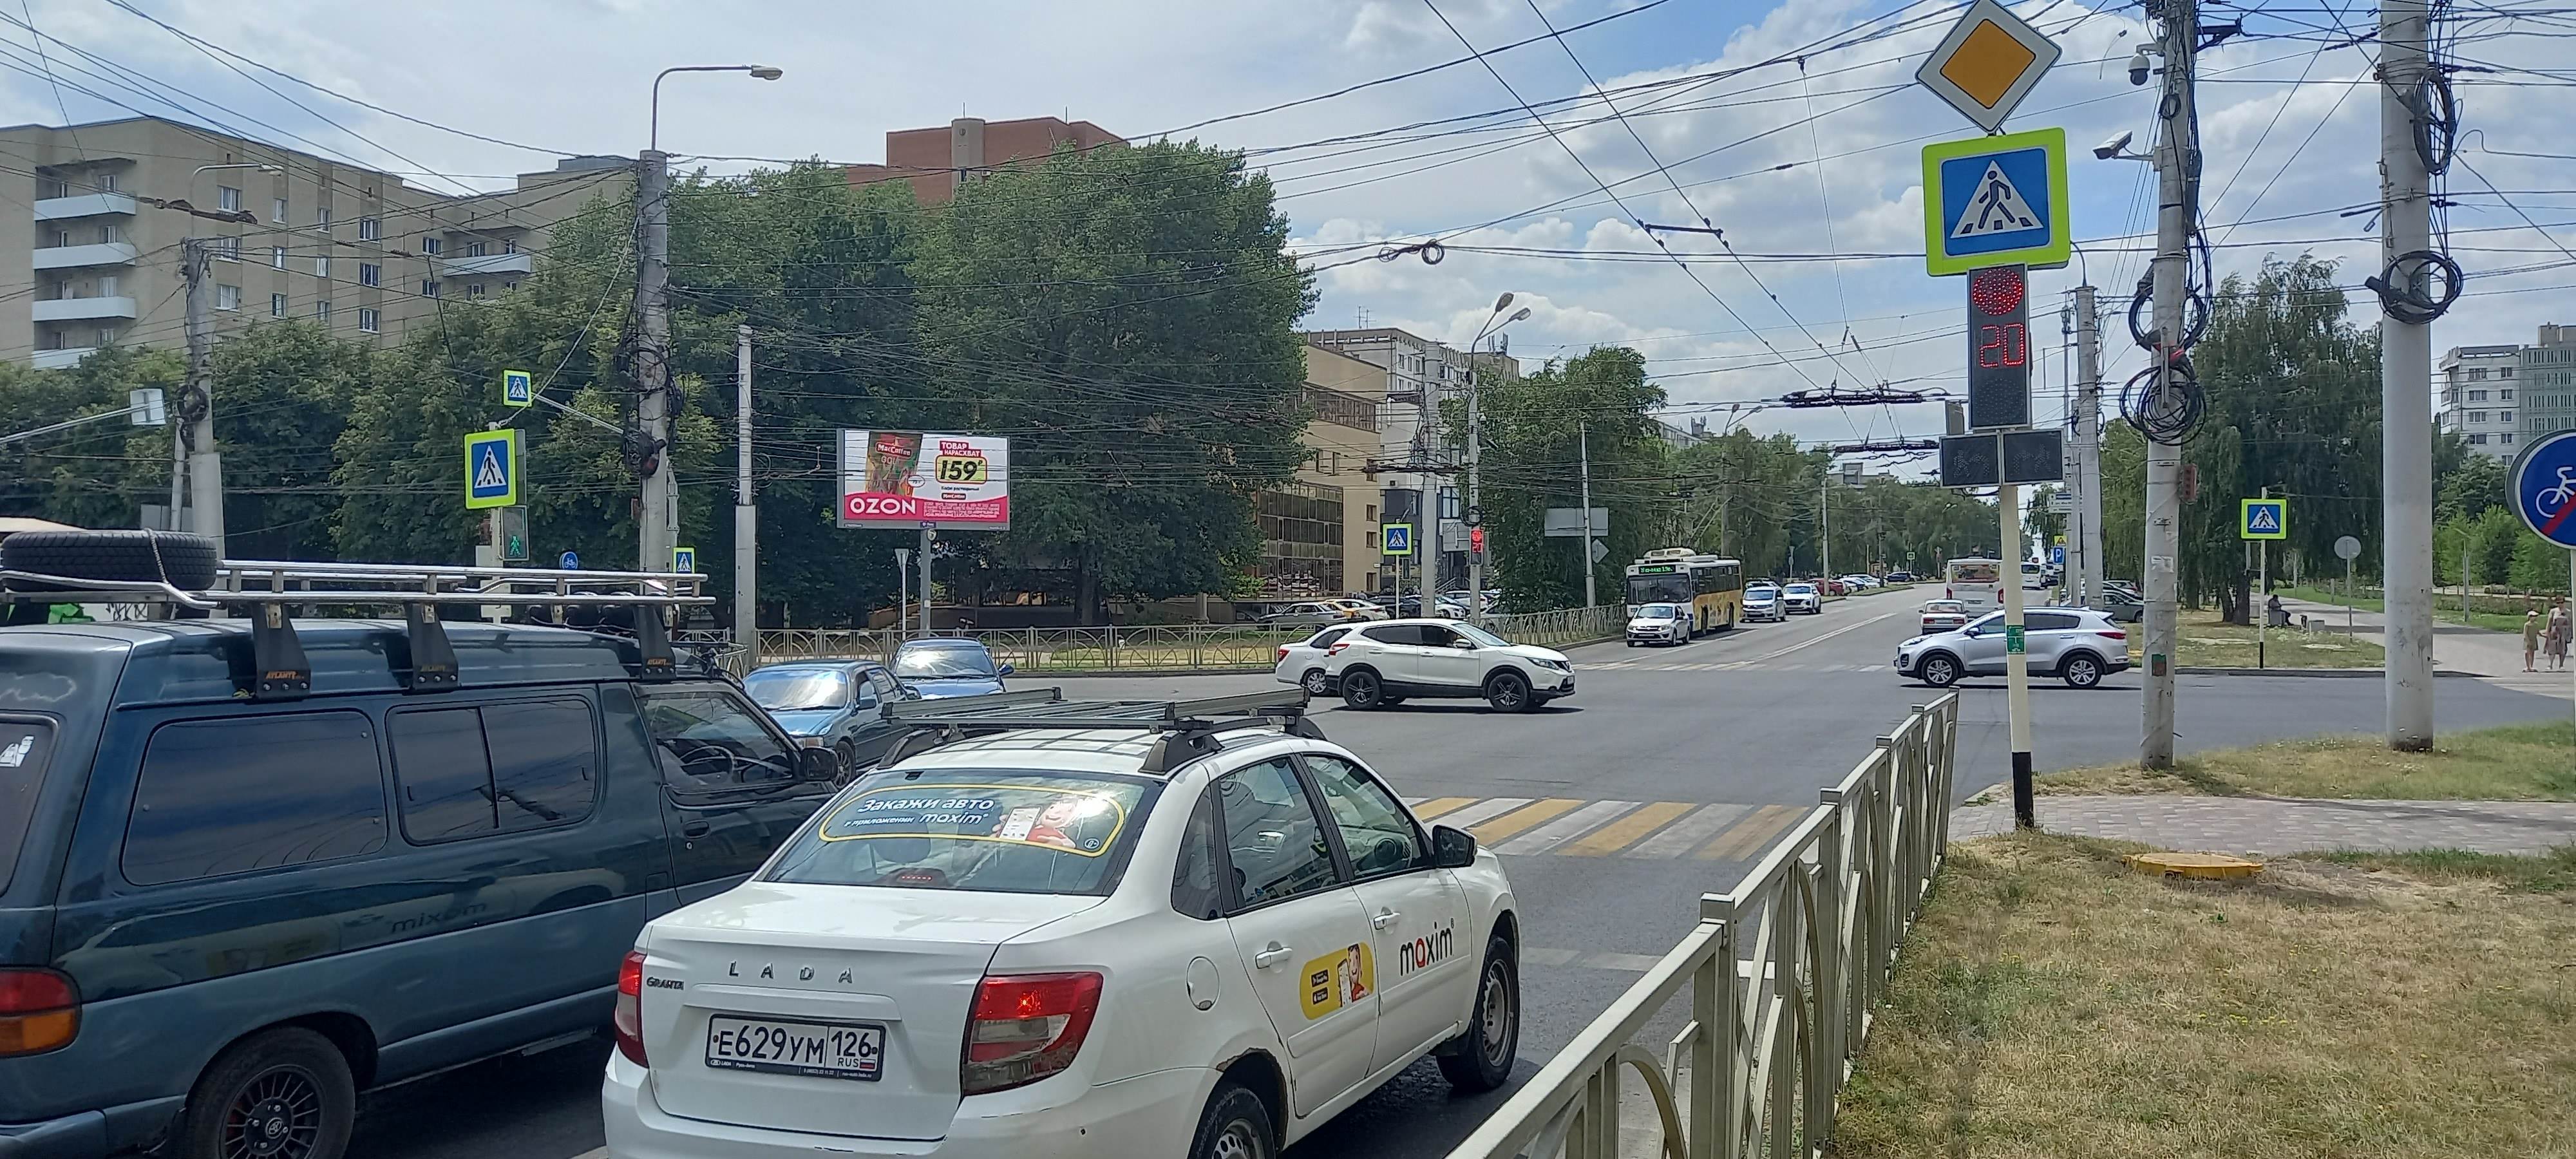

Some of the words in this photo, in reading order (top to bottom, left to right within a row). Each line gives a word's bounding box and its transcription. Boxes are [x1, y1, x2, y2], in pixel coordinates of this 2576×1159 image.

[1978, 323, 2024, 367] 20
[878, 444, 911, 456] MacCoffee
[941, 442, 967, 450] ТОВАР
[849, 497, 916, 514] OZON
[2056, 548, 2062, 562] P
[857, 798, 940, 814] Закажи
[942, 798, 995, 810] авто
[851, 816, 915, 827] приложении
[728, 960, 853, 984] LADA
[646, 976, 685, 990] GRANTA
[831, 1030, 871, 1058] 126
[837, 1057, 859, 1068] RUS
